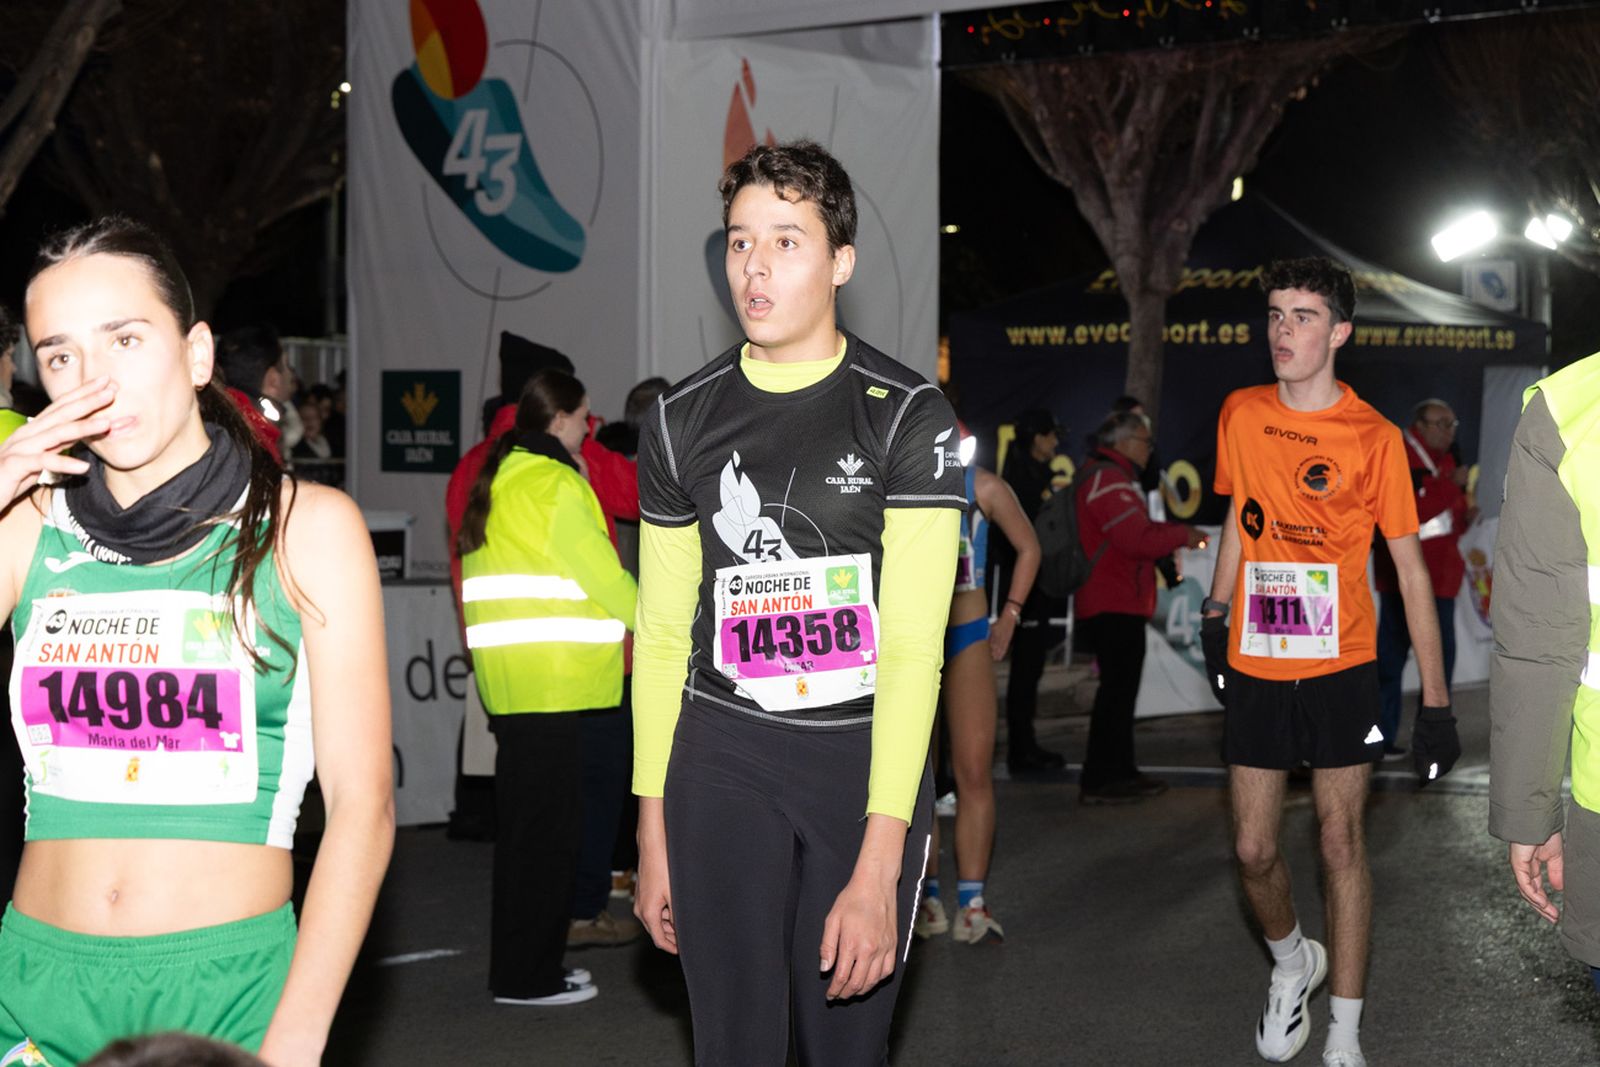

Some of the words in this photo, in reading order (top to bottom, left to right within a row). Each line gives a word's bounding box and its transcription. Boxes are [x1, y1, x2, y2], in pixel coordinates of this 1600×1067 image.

[443, 109, 522, 216] 43
[1263, 425, 1318, 446] GIVOVA
[825, 476, 847, 485] CAJA
[847, 476, 874, 485] RURAL
[840, 484, 862, 494] JAÉN
[745, 578, 790, 595] NOCHE
[793, 576, 811, 591] DE
[1287, 574, 1296, 582] DE
[1266, 583, 1297, 595] ANTÓN
[731, 598, 758, 616] SAN
[762, 591, 813, 613] ANTÓN
[68, 617, 131, 635] NOCHE
[136, 617, 160, 635] DE
[732, 609, 861, 662] 14358
[38, 643, 81, 663] SAN
[85, 637, 159, 664] ANTÓN
[405, 638, 468, 702] de
[38, 670, 223, 731] 14984
[130, 735, 152, 749] del
[156, 734, 181, 750] Mar
